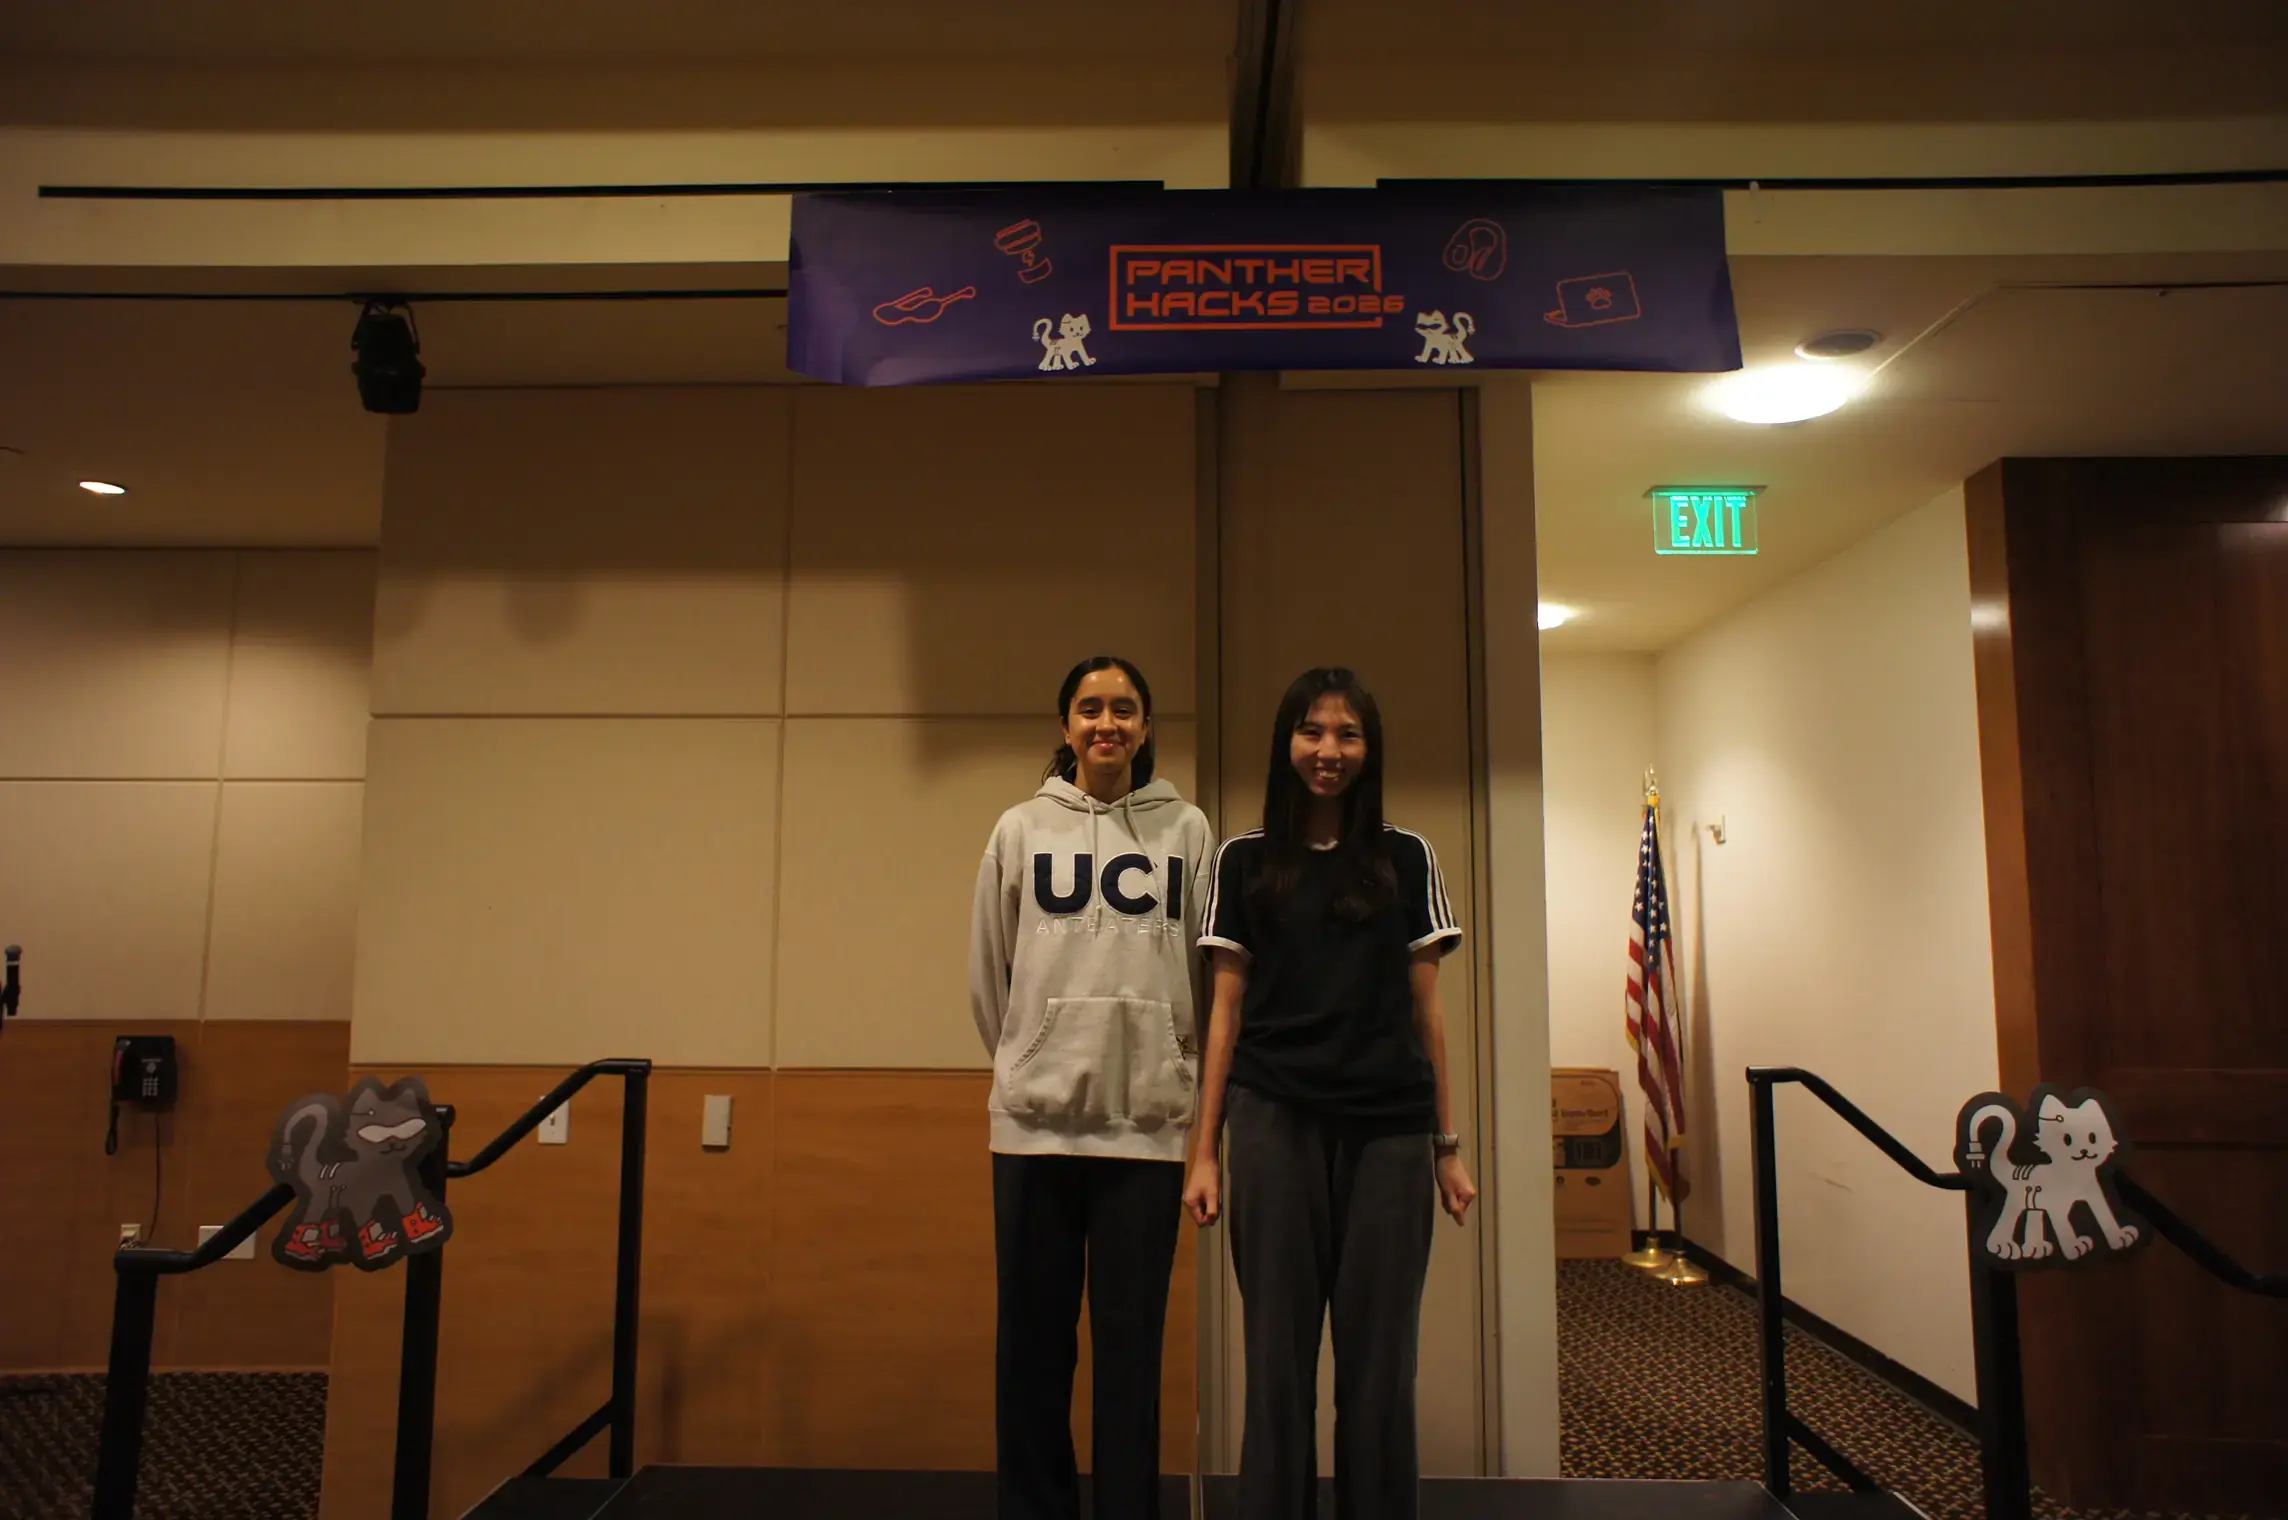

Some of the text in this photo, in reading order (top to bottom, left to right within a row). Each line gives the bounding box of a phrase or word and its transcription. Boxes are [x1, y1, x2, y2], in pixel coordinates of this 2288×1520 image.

[1126, 259, 1372, 285] PANTHER
[1126, 291, 1405, 317] HACKS 2026
[1670, 496, 1746, 547] EXIT
[1033, 852, 1184, 920] UCI
